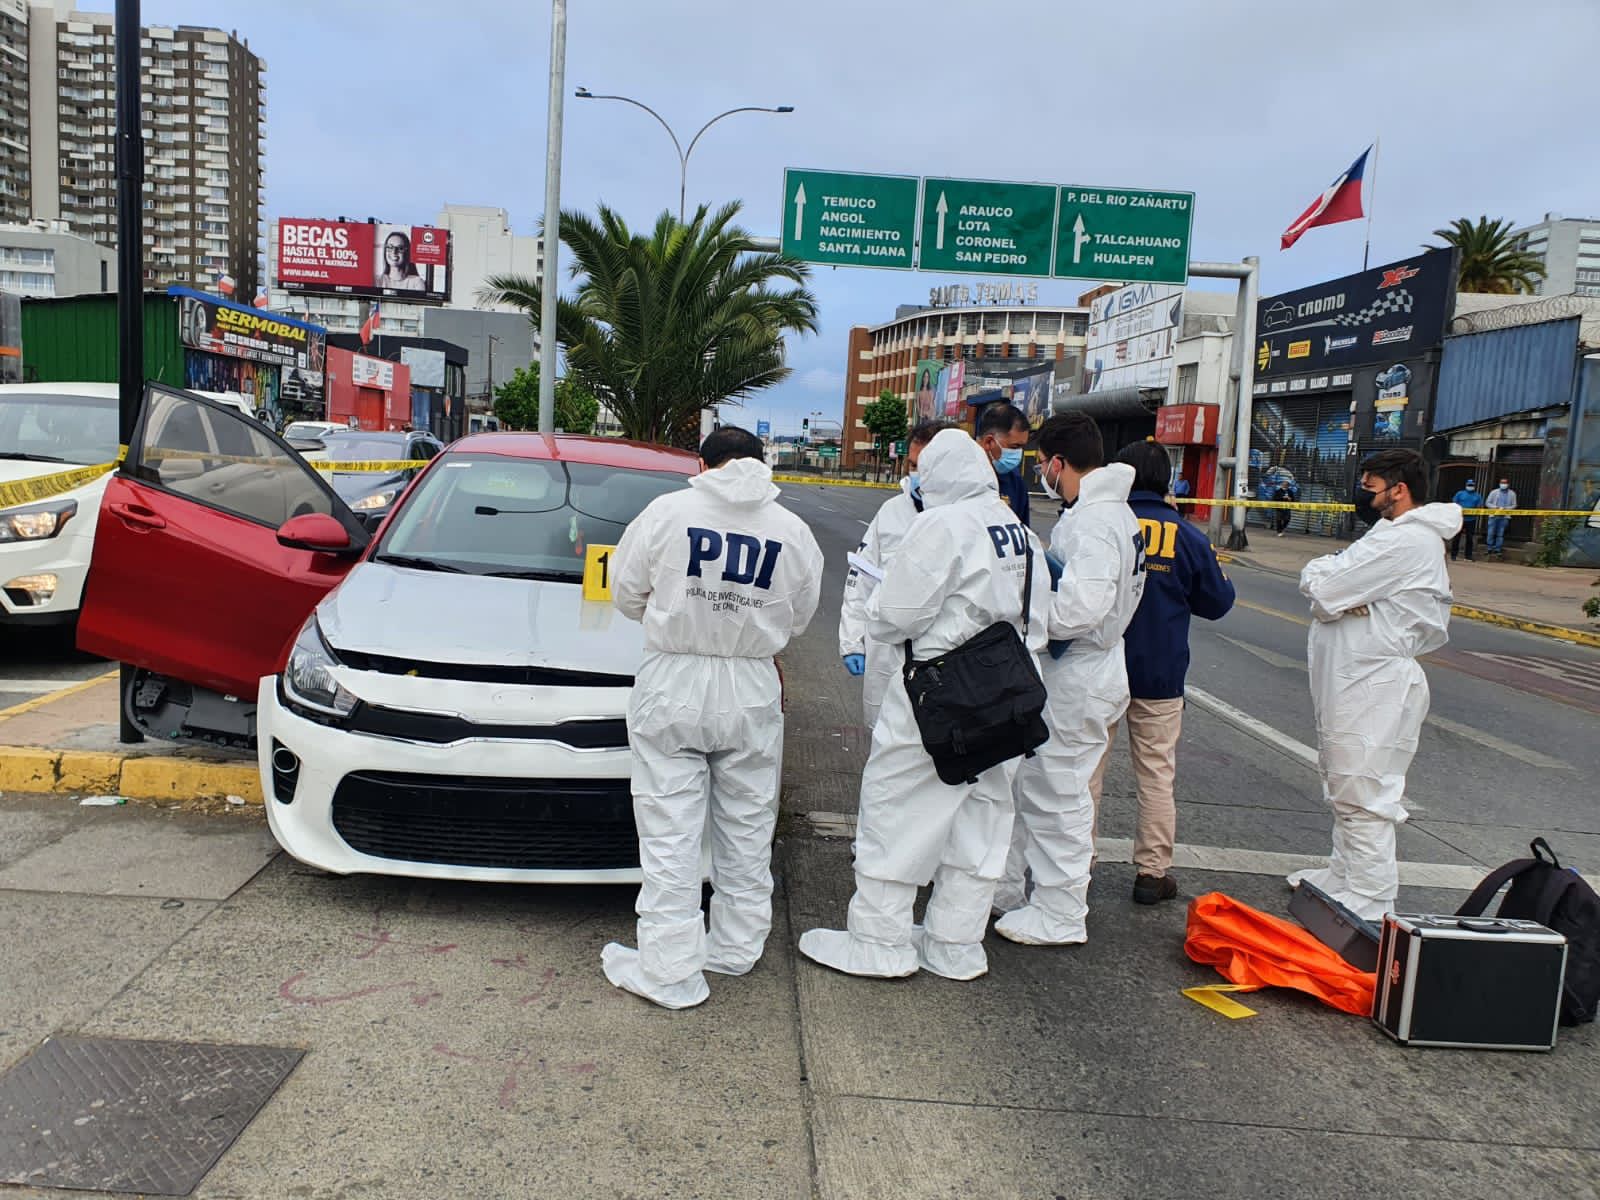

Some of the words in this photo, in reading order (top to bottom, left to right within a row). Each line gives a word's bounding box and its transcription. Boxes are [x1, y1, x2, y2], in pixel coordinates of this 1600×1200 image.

[822, 196, 876, 208] TEMUCO
[1067, 192, 1076, 202] P.
[1080, 193, 1102, 204] DEL
[1106, 195, 1127, 206] RIO
[1130, 194, 1187, 210] ZAÑARTU
[821, 212, 865, 223] ANGOL
[960, 205, 1013, 217] ARAUCO
[958, 221, 990, 231] LOTA
[283, 224, 348, 248] BECAS
[820, 226, 900, 241] NACIMIENTO
[956, 236, 1016, 248] CORONEL
[1095, 234, 1181, 248] TALCAHUANO
[283, 245, 315, 257] HASTA
[317, 247, 328, 258] EL
[331, 249, 358, 260] 100%
[818, 242, 860, 254] SANTA
[863, 245, 906, 257] JUANA
[955, 251, 981, 262] SAN
[984, 253, 1027, 264] PEDRO
[1093, 253, 1154, 265] HUALPEN
[216, 307, 306, 341] SERMOBAL
[987, 523, 1026, 559] PD
[687, 527, 783, 590] PDI
[597, 551, 609, 589] 1
[708, 591, 717, 601] DE
[713, 602, 721, 612] DE
